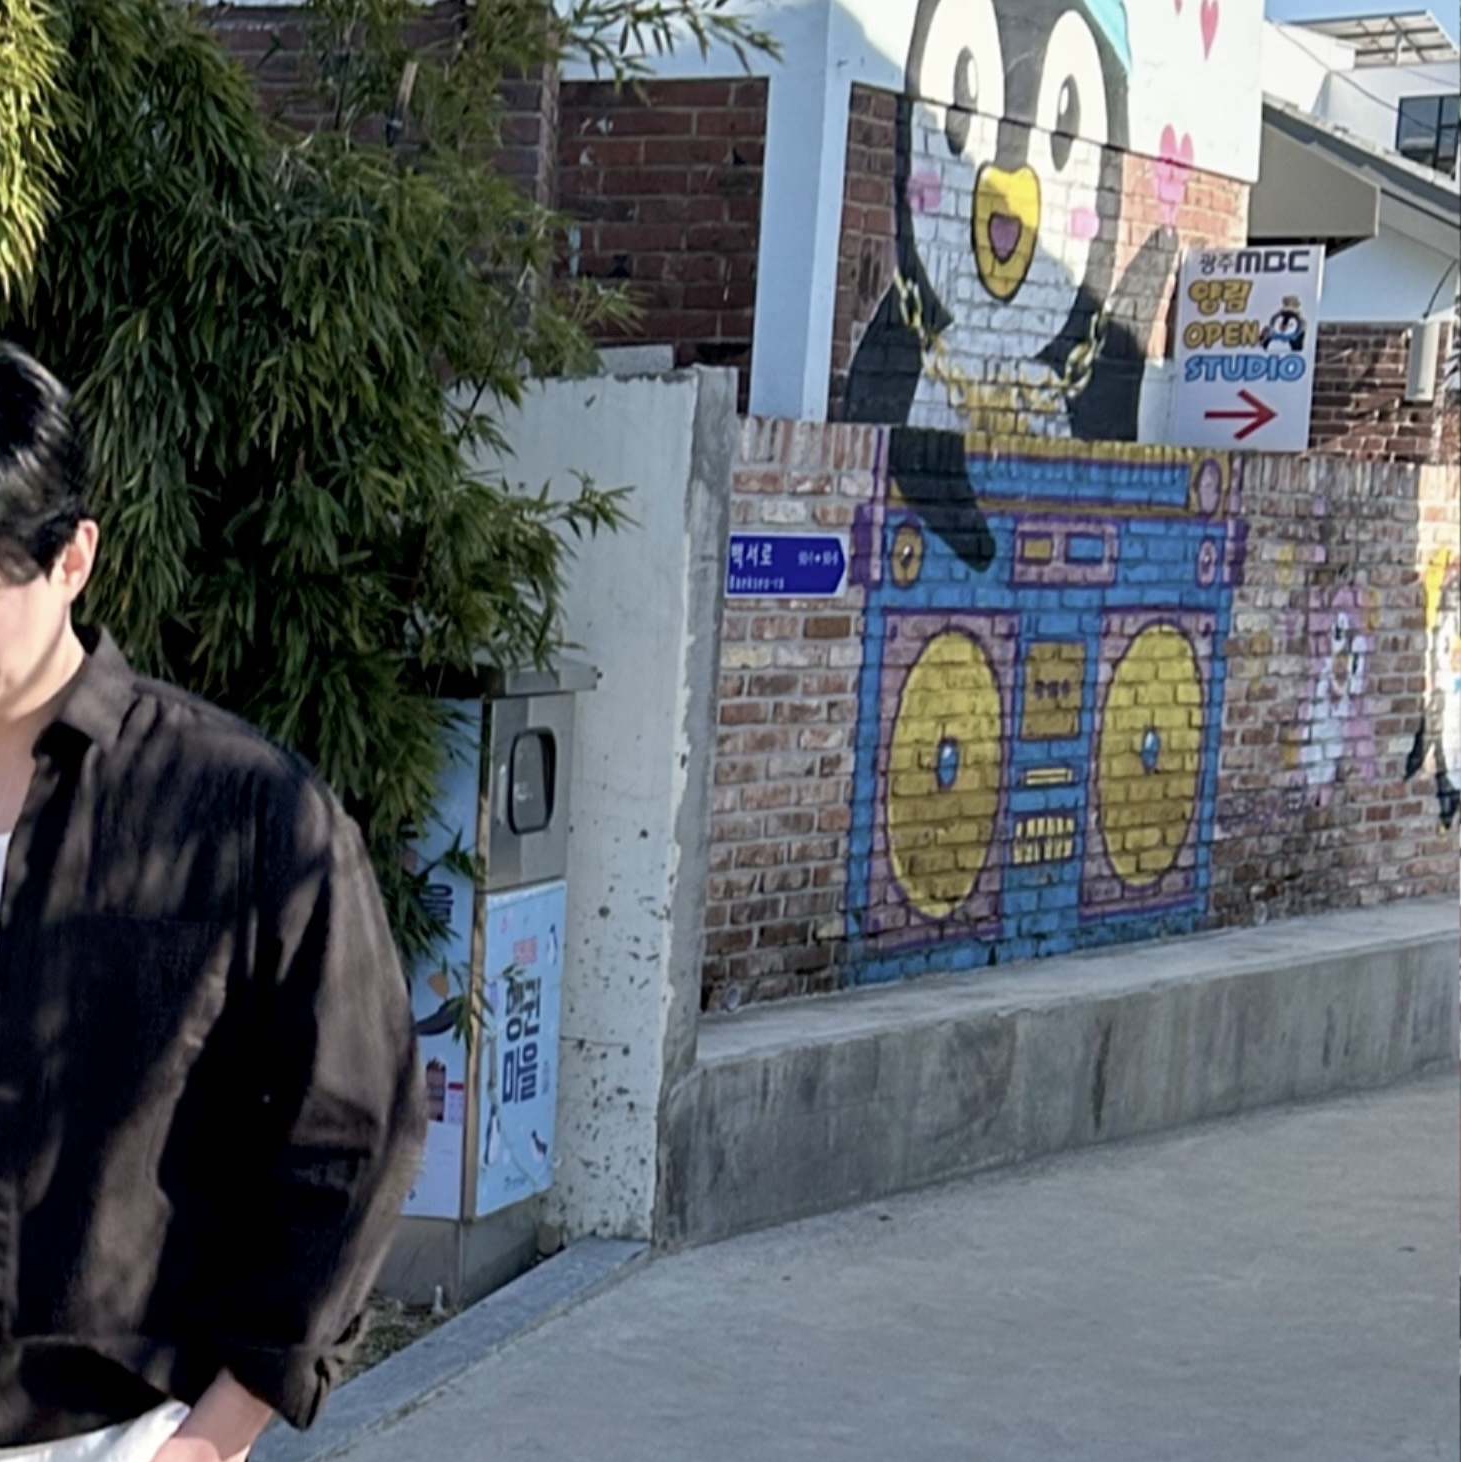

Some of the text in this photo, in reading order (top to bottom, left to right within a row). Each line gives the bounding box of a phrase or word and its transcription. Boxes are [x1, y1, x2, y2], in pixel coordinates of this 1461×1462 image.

[1189, 280, 1253, 316] 양림
[1183, 320, 1260, 350] OPEN
[1184, 354, 1306, 383] STUDIO
[502, 1042, 538, 1104] 마을
